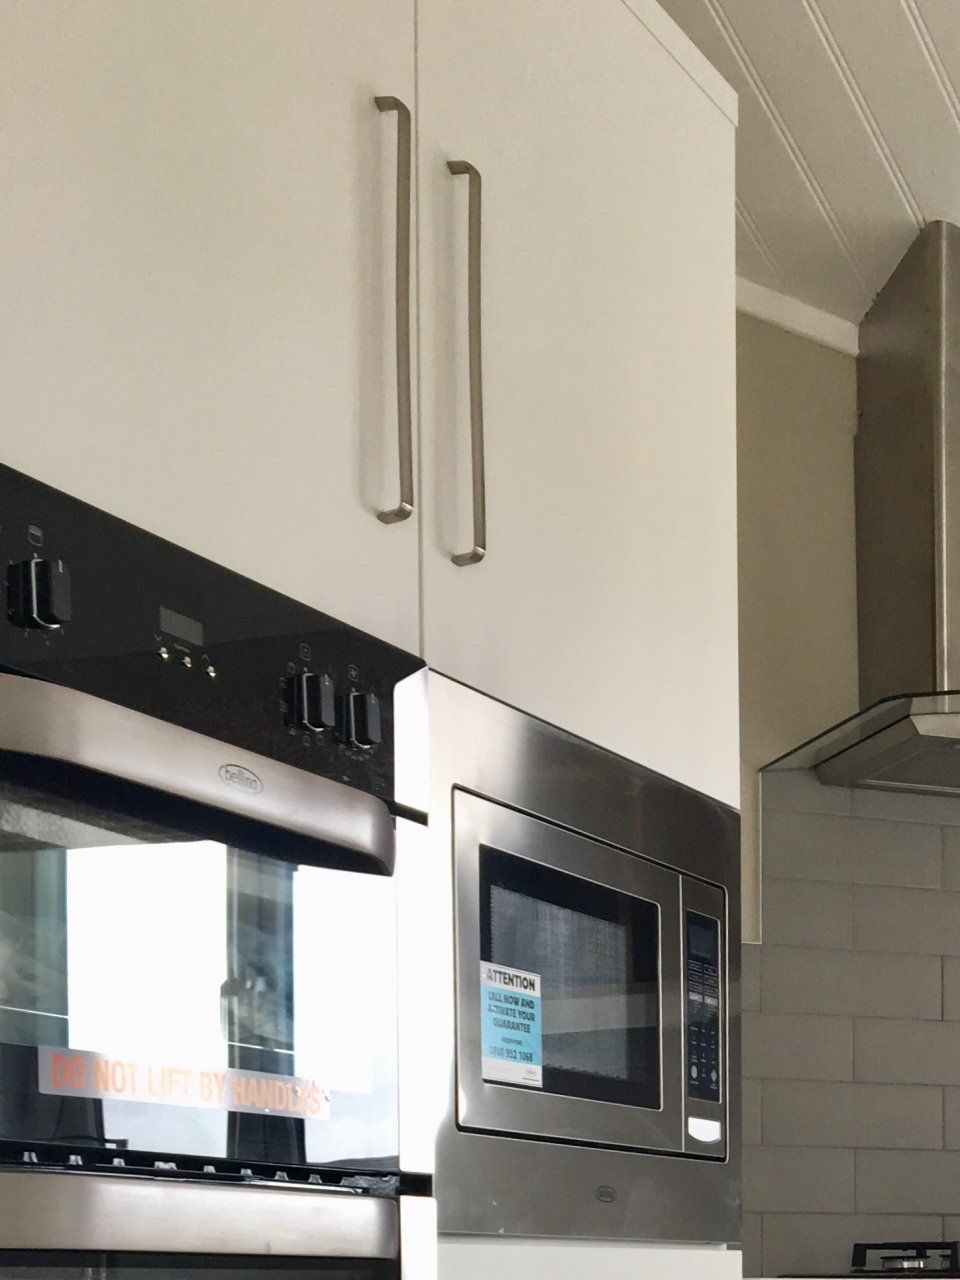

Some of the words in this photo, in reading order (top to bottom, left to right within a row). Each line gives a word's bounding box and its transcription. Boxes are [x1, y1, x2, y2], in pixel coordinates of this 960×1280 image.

[487, 968, 536, 991] ATTENTION
[503, 994, 520, 1006] NOW
[521, 998, 535, 1010] AND
[518, 1009, 535, 1022] YOUR
[493, 1017, 531, 1034] GUARANTEE
[52, 1052, 88, 1090] DO
[92, 1058, 139, 1095] NOT
[147, 1064, 192, 1099] LIFT
[200, 1071, 227, 1104] BY
[231, 1075, 321, 1114] HANDLES
